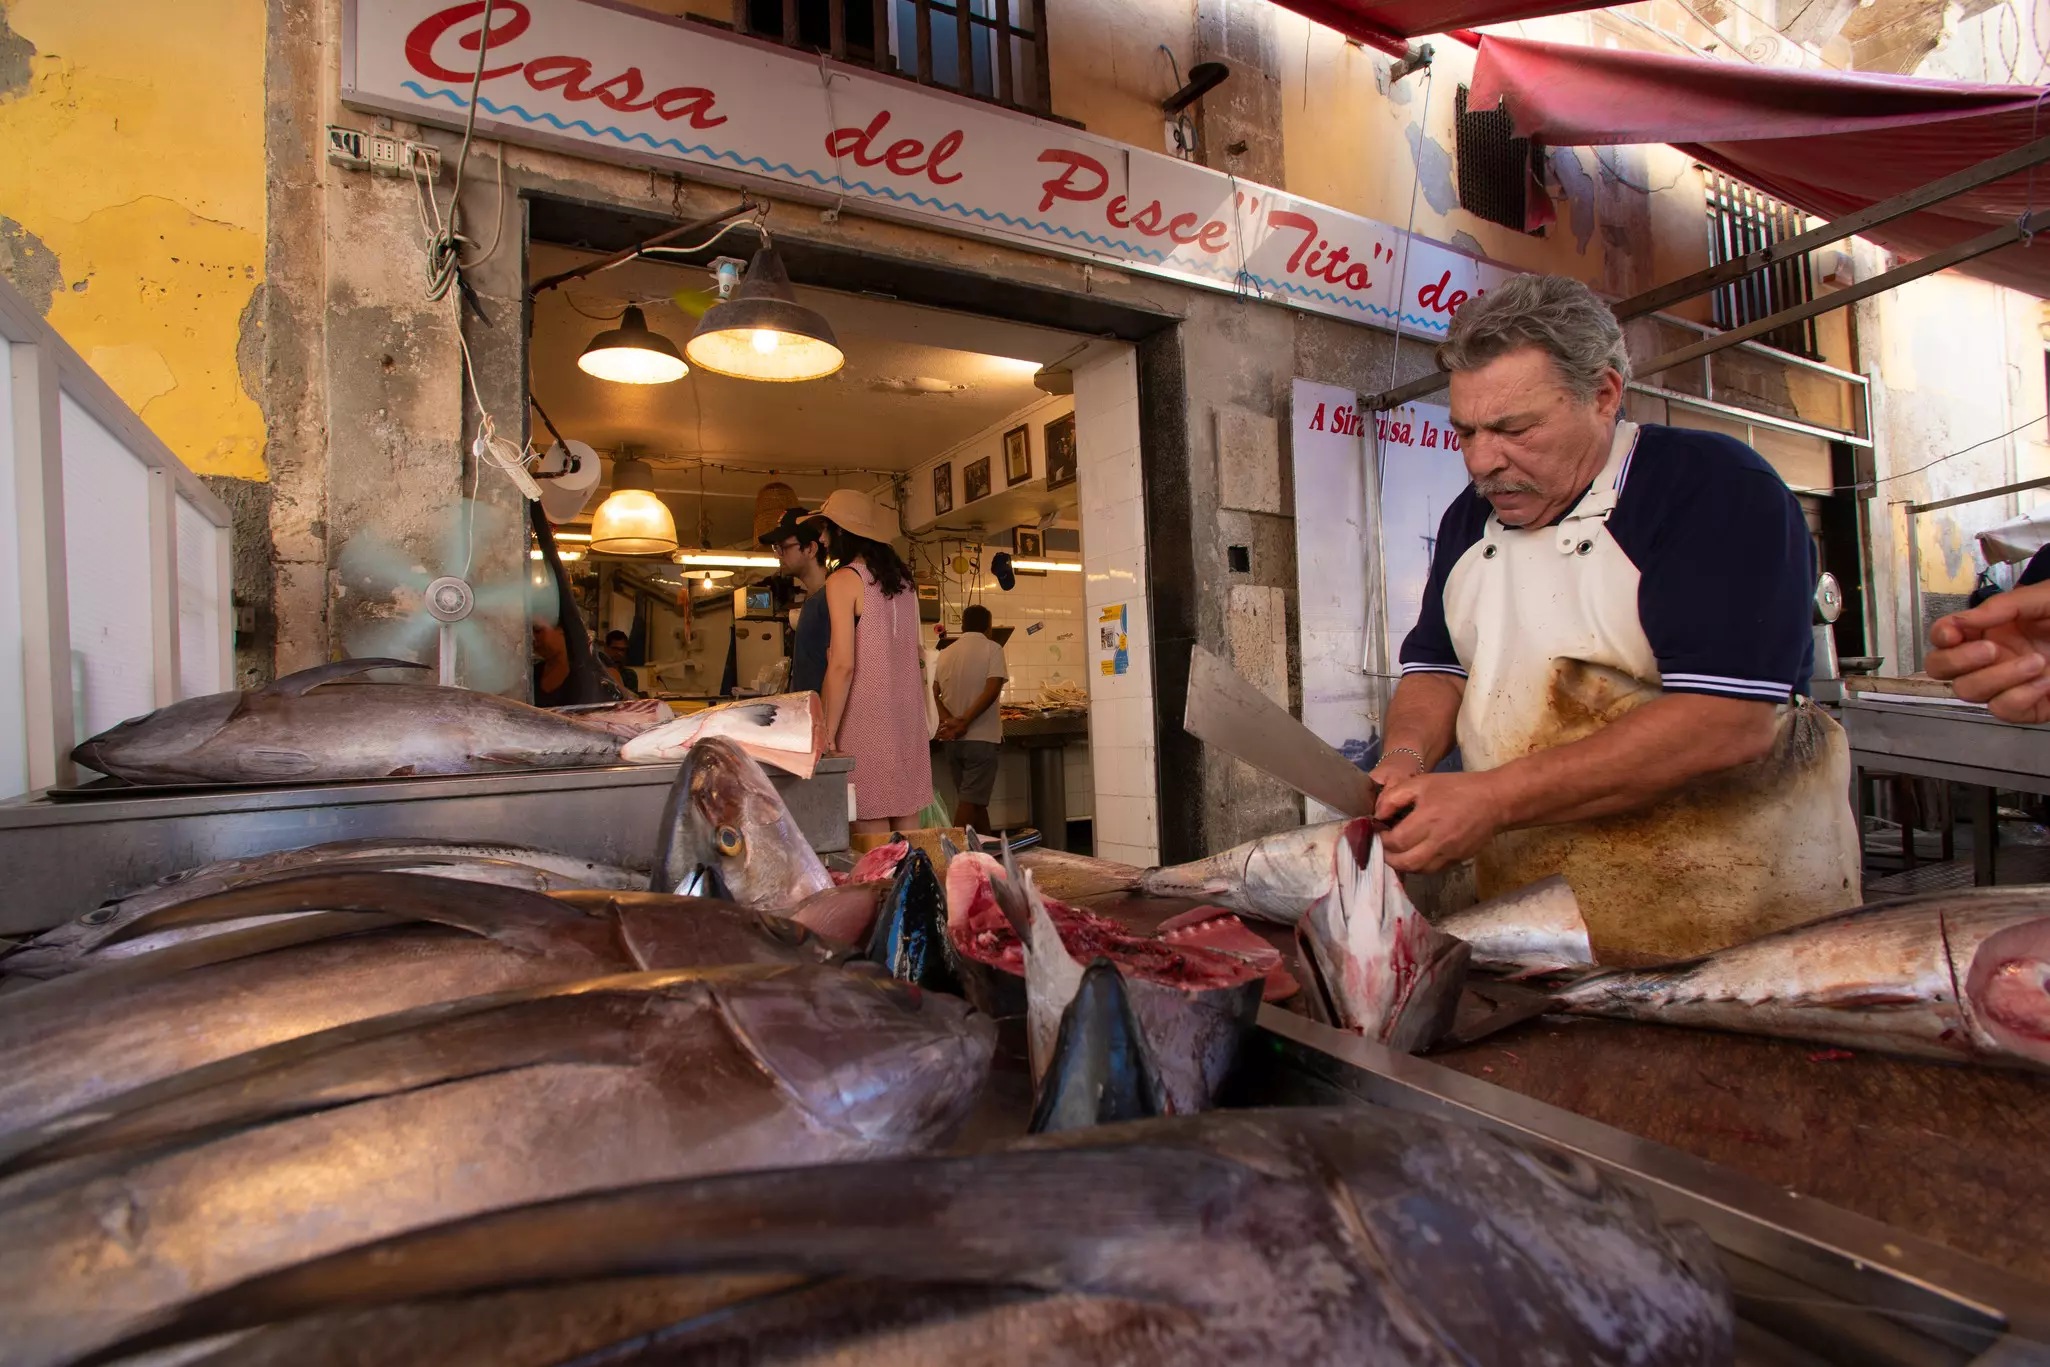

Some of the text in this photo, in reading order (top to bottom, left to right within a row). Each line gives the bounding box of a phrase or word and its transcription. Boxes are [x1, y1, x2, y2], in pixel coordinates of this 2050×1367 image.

[405, 0, 727, 130] Casa
[824, 110, 964, 186] del
[1037, 148, 1231, 253] Pesce
[1309, 402, 1326, 431] A
[1420, 420, 1439, 449] la
